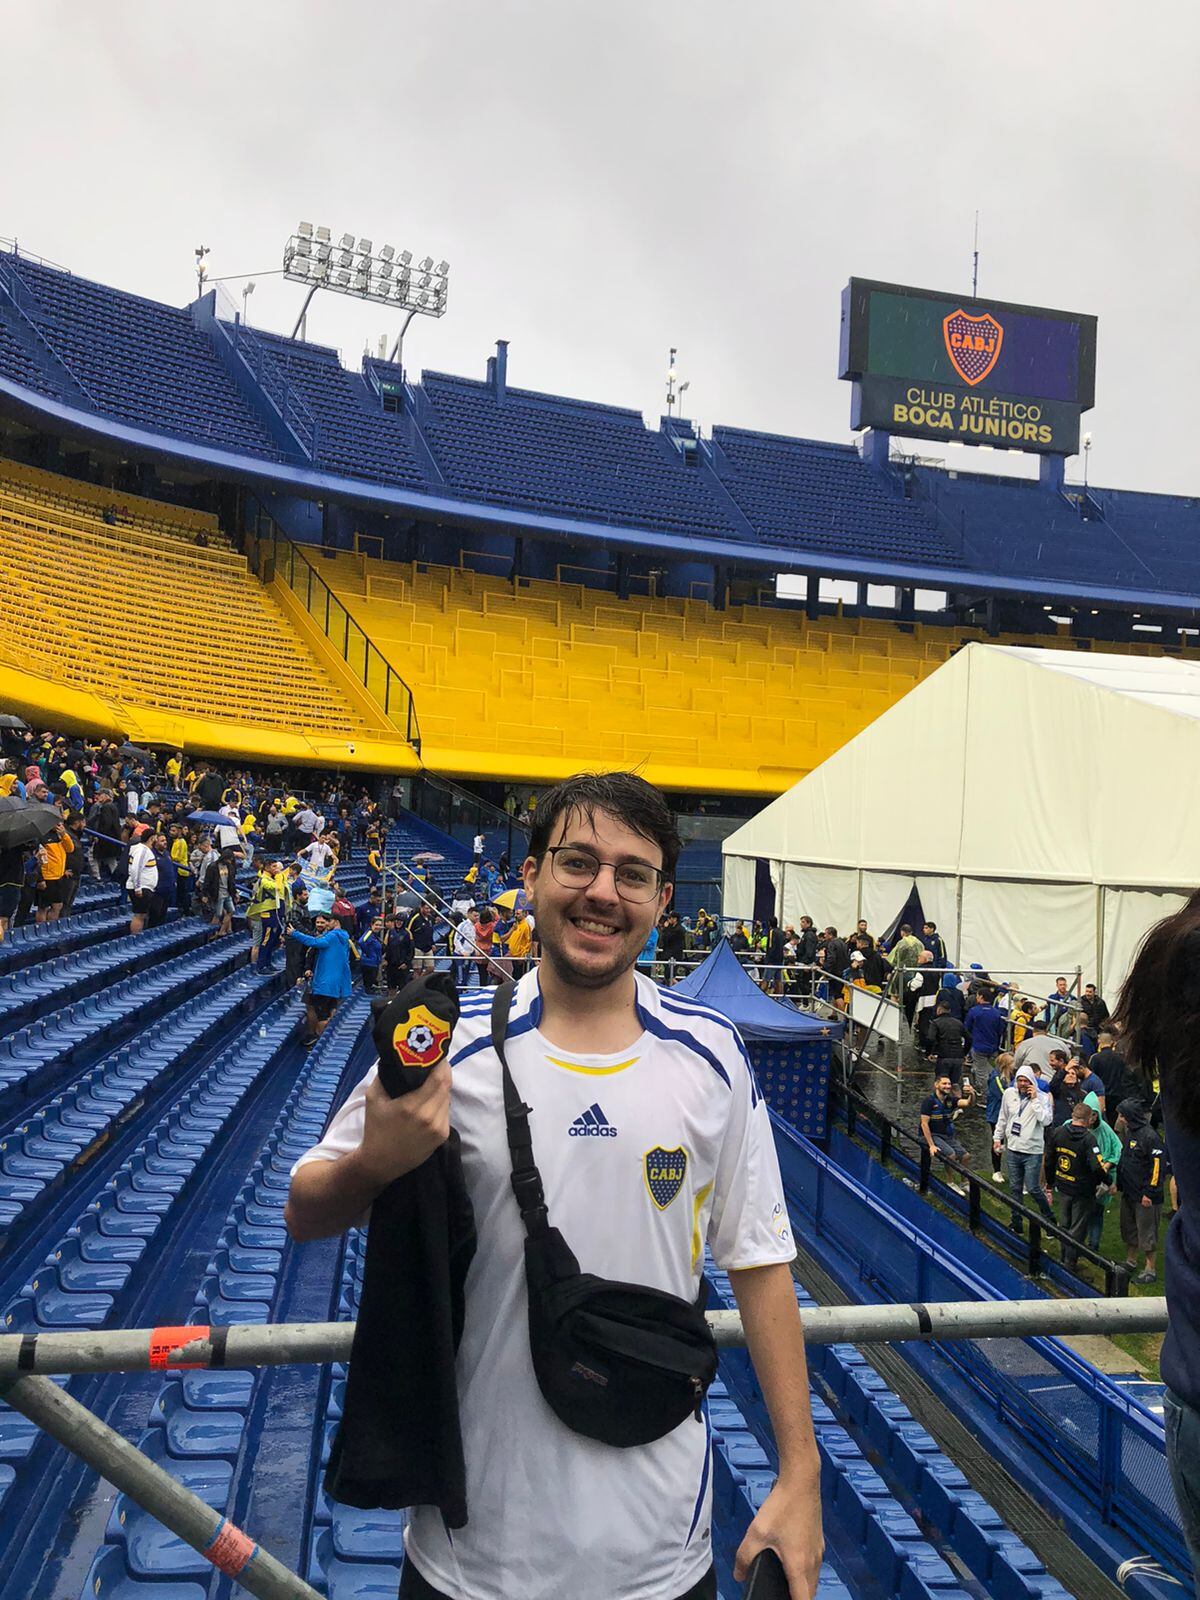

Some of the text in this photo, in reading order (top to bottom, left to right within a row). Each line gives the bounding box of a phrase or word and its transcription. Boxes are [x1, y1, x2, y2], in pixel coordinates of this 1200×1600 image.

[951, 332, 994, 352] CABJ
[907, 387, 1041, 422] CLUB ATLÉTICO
[893, 403, 1053, 443] BOCA JUNIORS
[568, 1125, 618, 1137] adidas
[650, 1168, 683, 1181] CABJ
